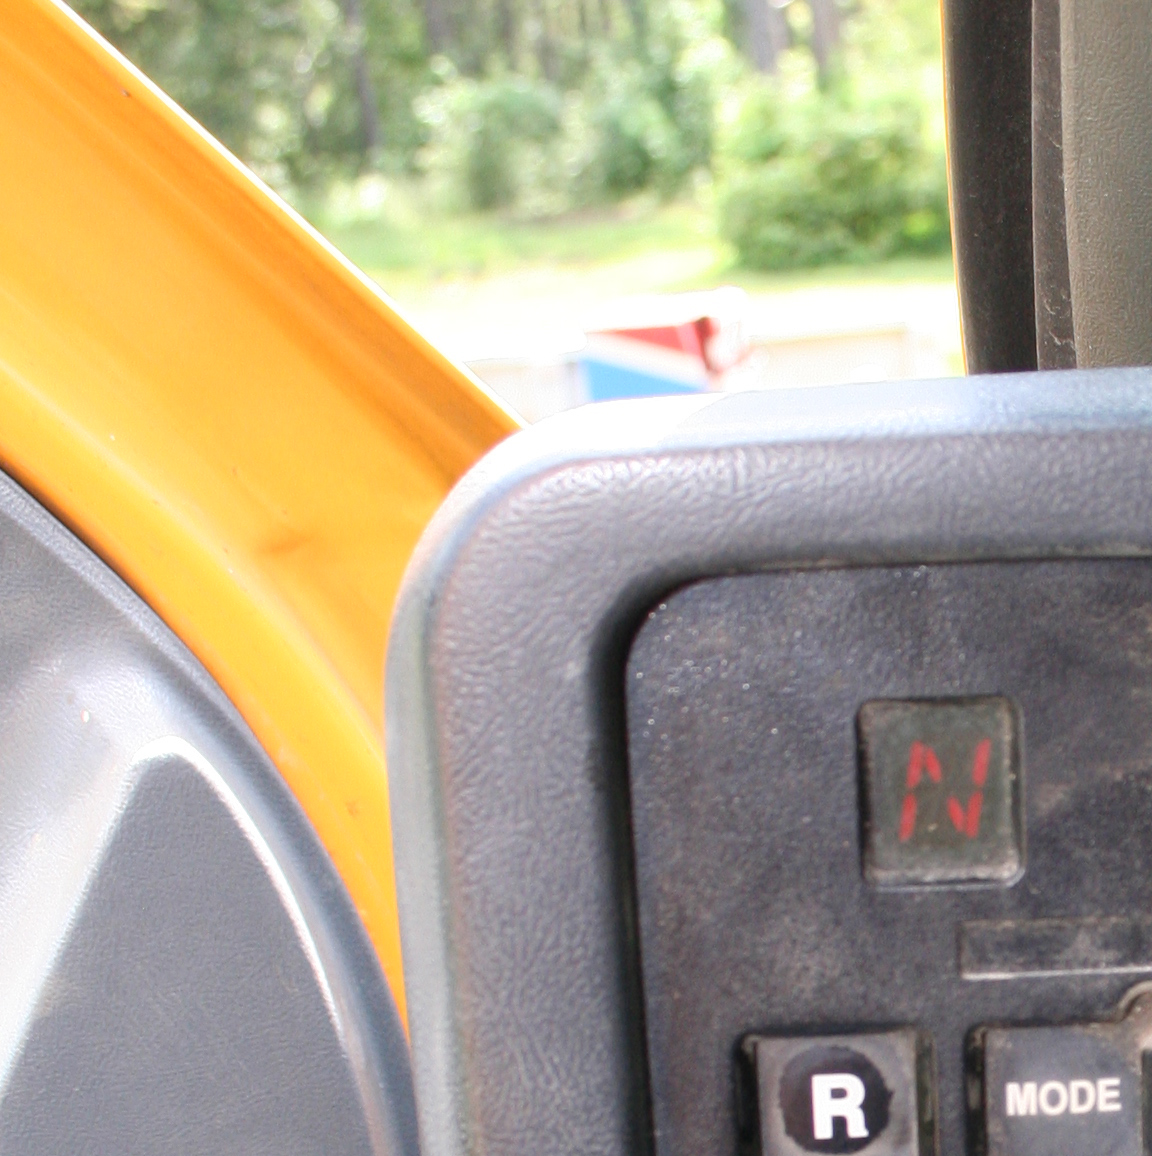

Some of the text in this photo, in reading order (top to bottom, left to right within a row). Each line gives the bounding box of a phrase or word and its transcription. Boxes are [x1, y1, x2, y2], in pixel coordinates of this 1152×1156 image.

[898, 739, 991, 842] N
[811, 1073, 869, 1140] R
[1005, 1077, 1123, 1117] MODE
